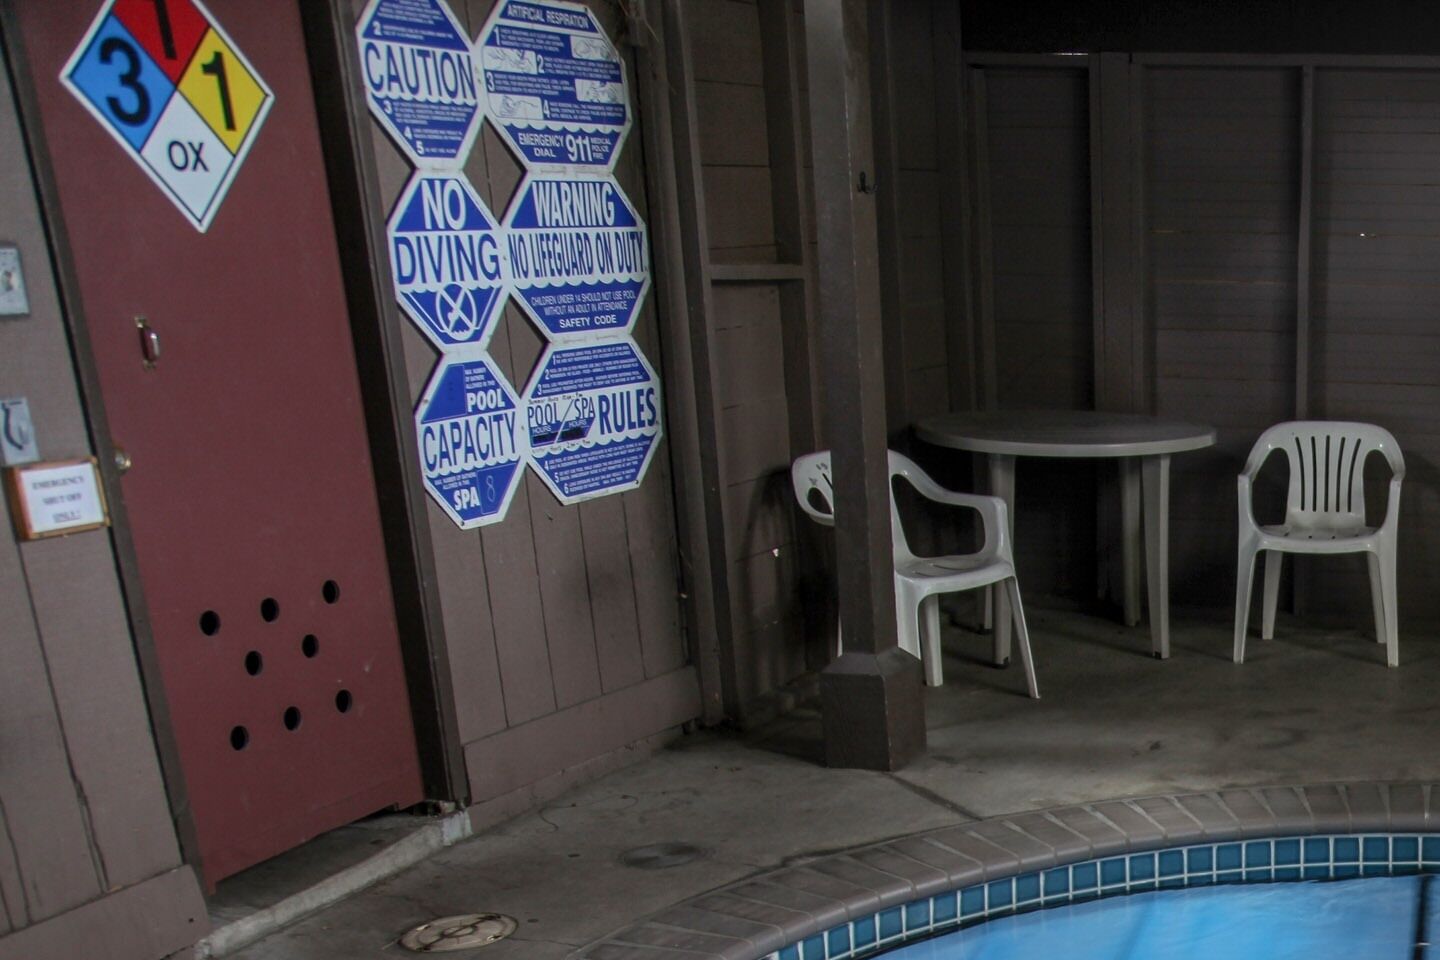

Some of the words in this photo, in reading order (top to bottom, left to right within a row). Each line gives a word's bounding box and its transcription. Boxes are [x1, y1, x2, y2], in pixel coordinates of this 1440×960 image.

[508, 4, 546, 22] ARTIFICIAL
[546, 10, 590, 29] RESPIRATION
[372, 21, 382, 35] 2
[493, 28, 500, 46] 1
[364, 41, 477, 100] CAUTION
[537, 54, 545, 74] 2
[99, 36, 151, 127] 3
[201, 50, 237, 131] 1
[486, 72, 496, 92] 3
[383, 100, 393, 114] 3
[543, 99, 550, 118] 4
[404, 125, 413, 140] 4
[168, 140, 209, 172] OX
[416, 140, 425, 155] 5
[518, 133, 565, 147] EMERGENCY
[565, 134, 592, 162] 911
[533, 147, 557, 158] DIAL
[420, 179, 466, 231] NO
[531, 181, 615, 227] WARNING
[393, 233, 501, 285] DIVING
[507, 233, 529, 279] NO
[529, 231, 594, 278] LIFEGUARD
[595, 231, 614, 275] ON
[614, 231, 644, 273] DUTY
[531, 294, 557, 306] CHILDREN
[581, 291, 601, 303] SHOULD
[612, 290, 622, 300] USE
[622, 289, 636, 299] POOL
[559, 317, 591, 328] SAFETY
[593, 314, 617, 325] CODE
[544, 369, 550, 380] 2
[538, 384, 543, 395] 3
[466, 388, 505, 413] POOL
[527, 402, 561, 428] POOL
[574, 396, 595, 419] SPA
[598, 386, 657, 435] RULES
[423, 411, 516, 472] CAPACITY
[544, 460, 550, 471] 4
[554, 472, 560, 483] 5
[453, 486, 480, 511] SPA
[486, 475, 496, 502] 8
